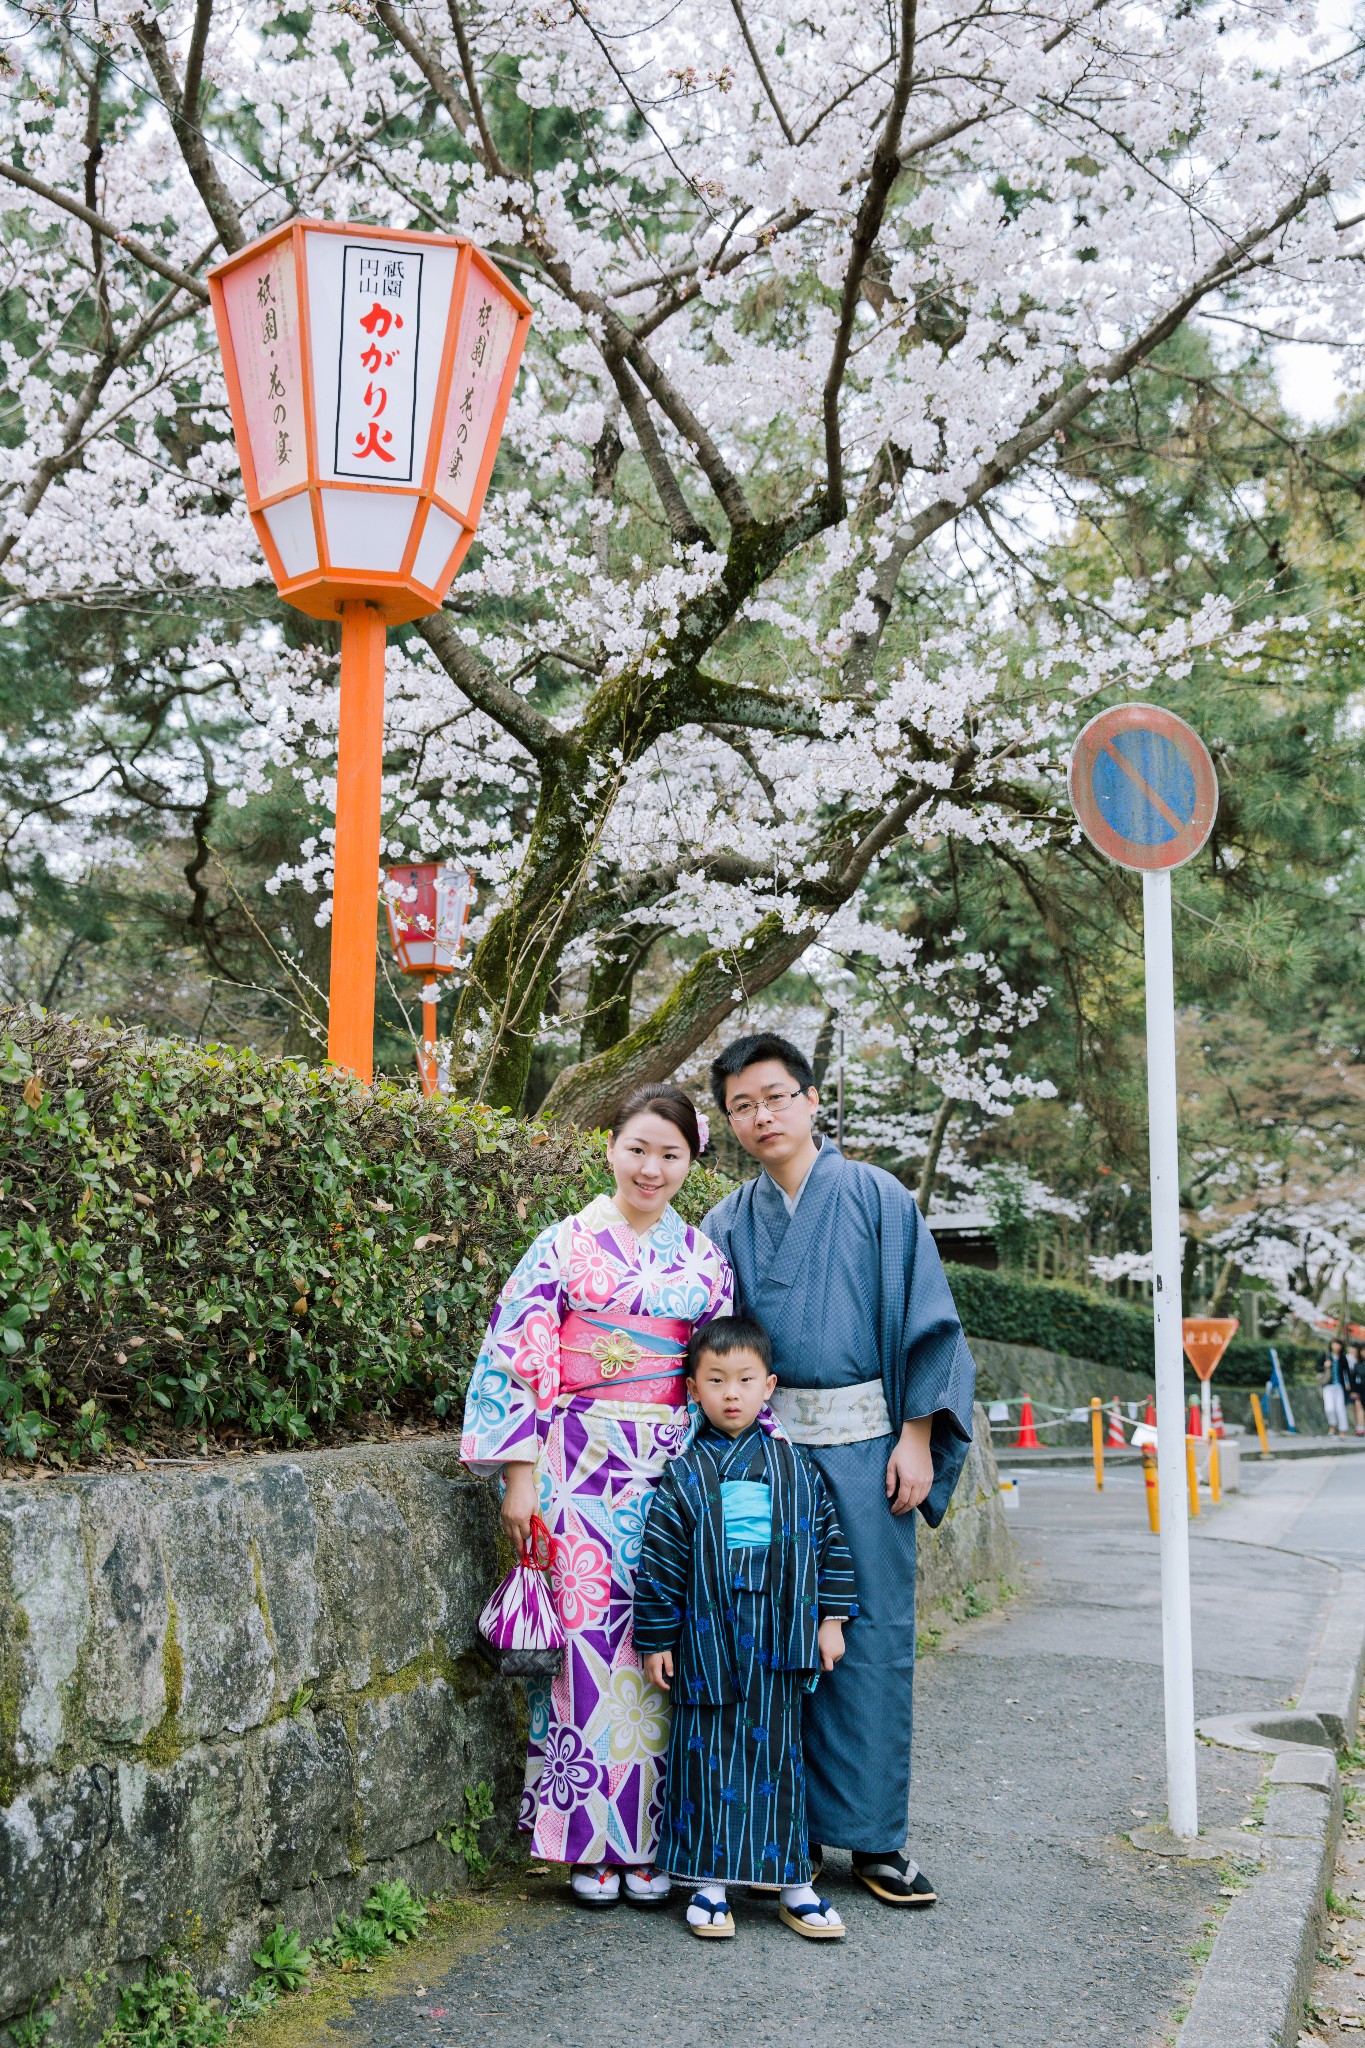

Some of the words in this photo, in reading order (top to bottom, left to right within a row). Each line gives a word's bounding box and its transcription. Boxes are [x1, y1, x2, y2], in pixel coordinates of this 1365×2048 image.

[359, 258, 379, 295] 円山
[351, 302, 404, 463] かがり火
